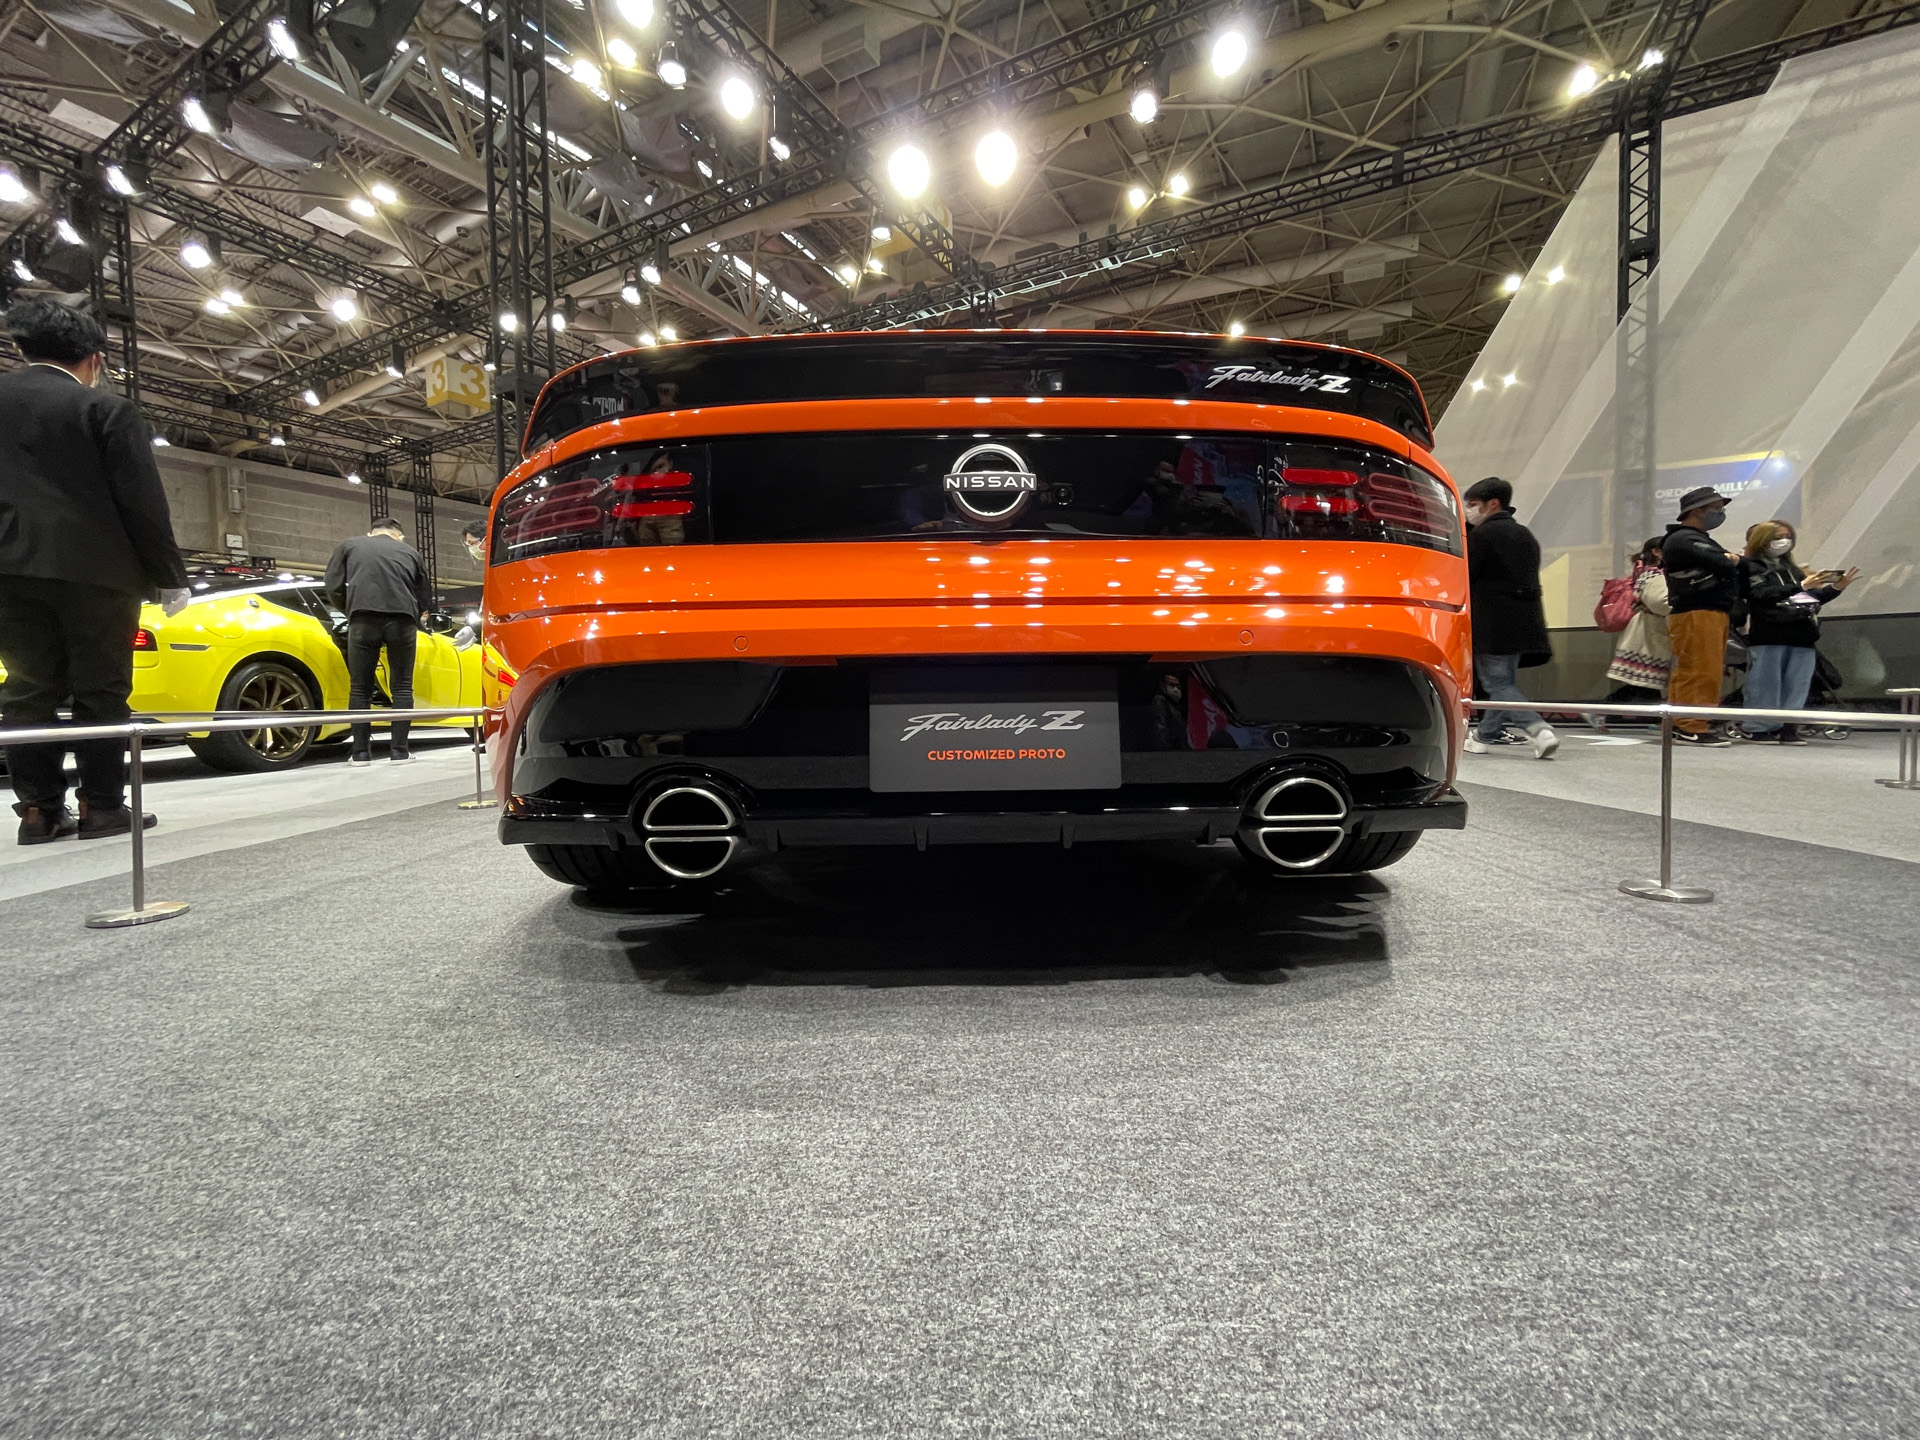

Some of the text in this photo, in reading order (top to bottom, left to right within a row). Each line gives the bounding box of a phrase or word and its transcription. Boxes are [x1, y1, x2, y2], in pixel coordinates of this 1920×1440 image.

[432, 359, 446, 396] 3
[460, 363, 487, 399] 3
[1204, 365, 1352, 394] Fairlady Z
[946, 476, 1035, 489] NISSAN
[899, 709, 1086, 742] Fairlady Z
[927, 748, 1066, 761] CUSTOMIZED PROTO
